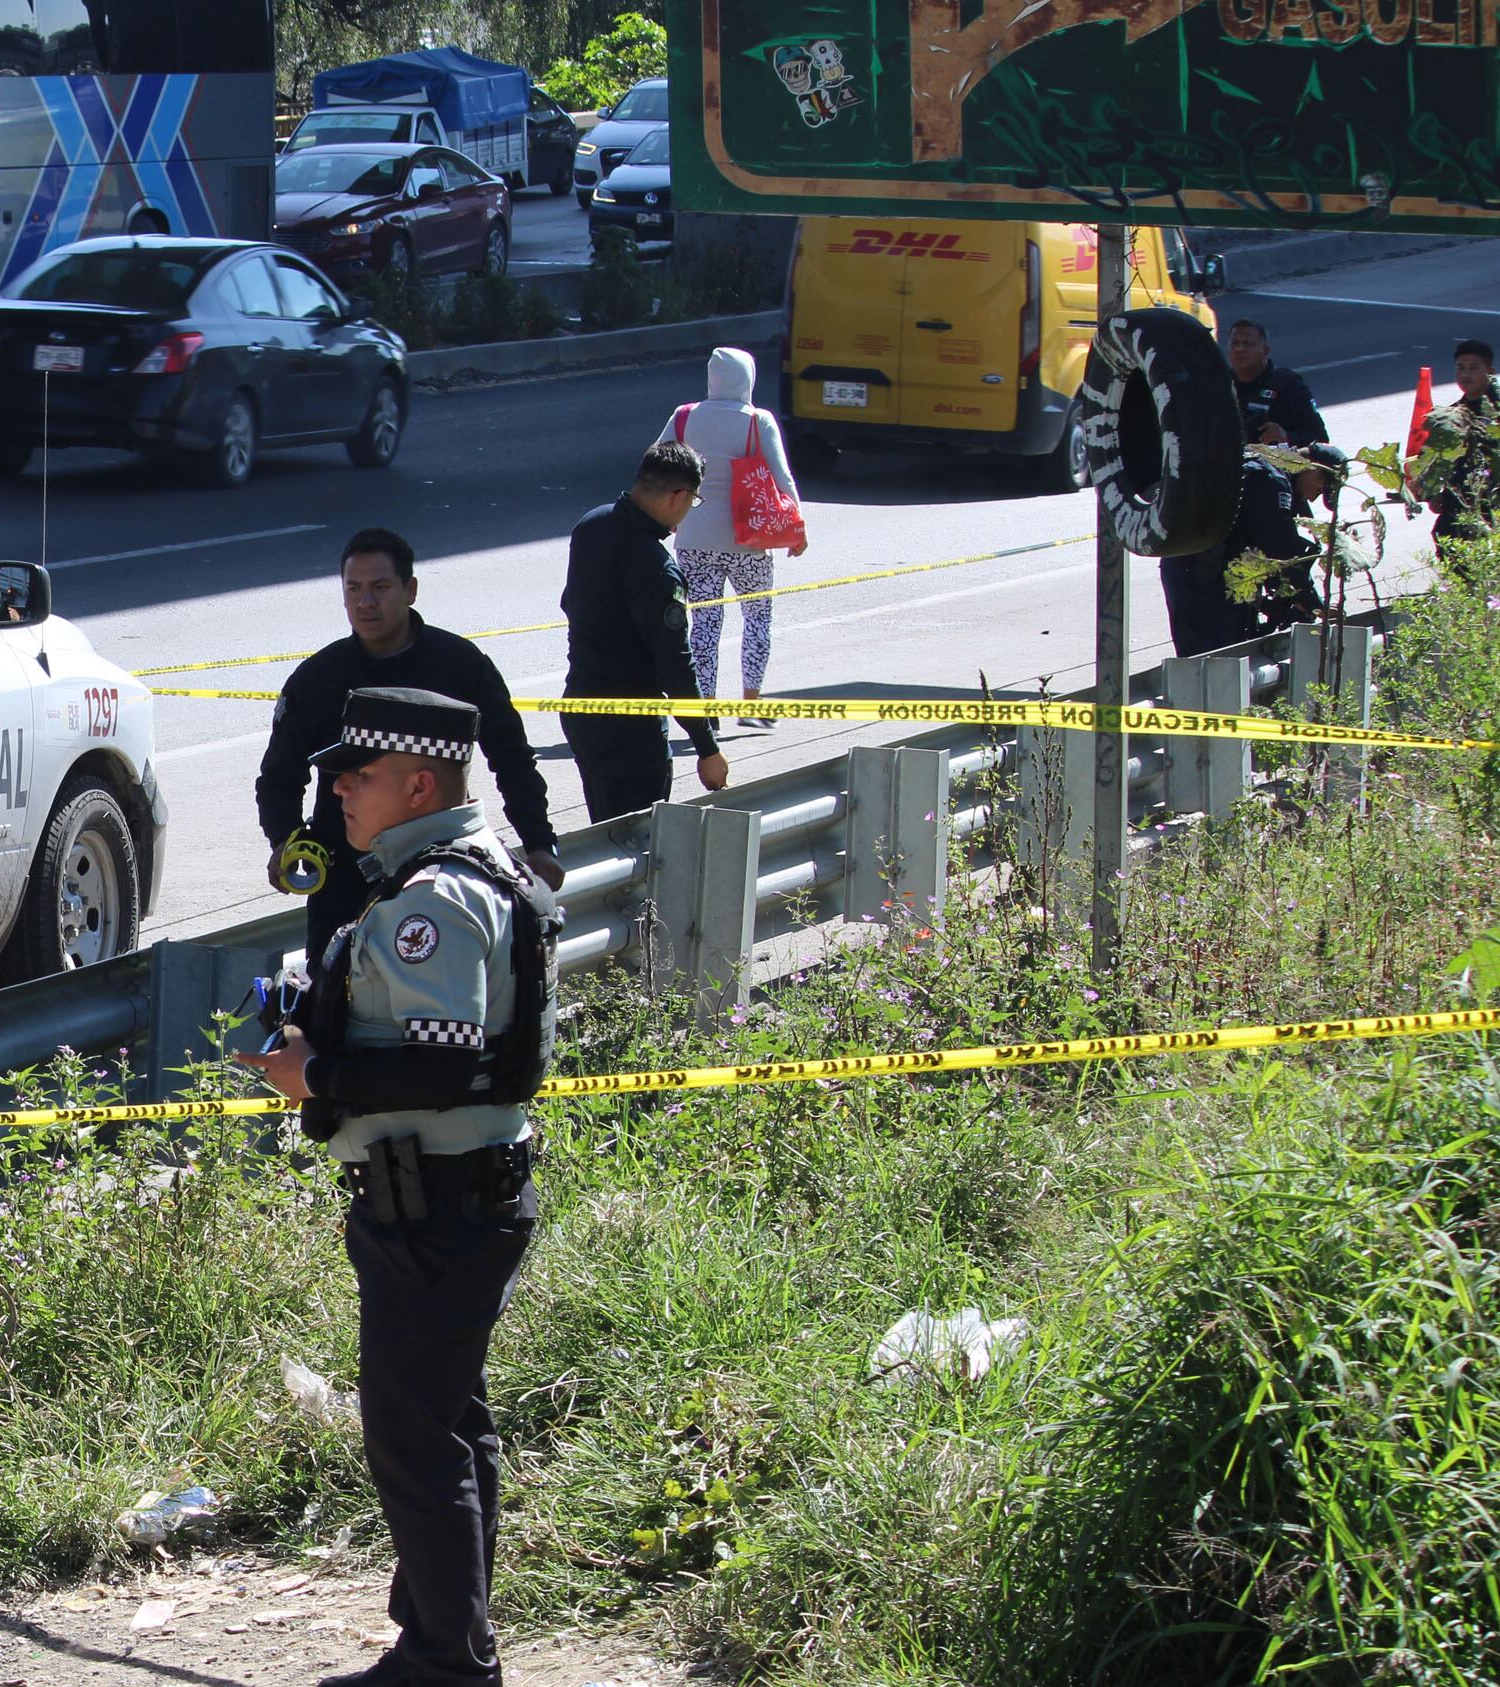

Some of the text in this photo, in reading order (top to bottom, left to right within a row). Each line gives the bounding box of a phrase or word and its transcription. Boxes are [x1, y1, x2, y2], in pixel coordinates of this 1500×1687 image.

[1219, 0, 1500, 46] GASOLI
[849, 229, 966, 259] DHL
[84, 687, 118, 737] 1297
